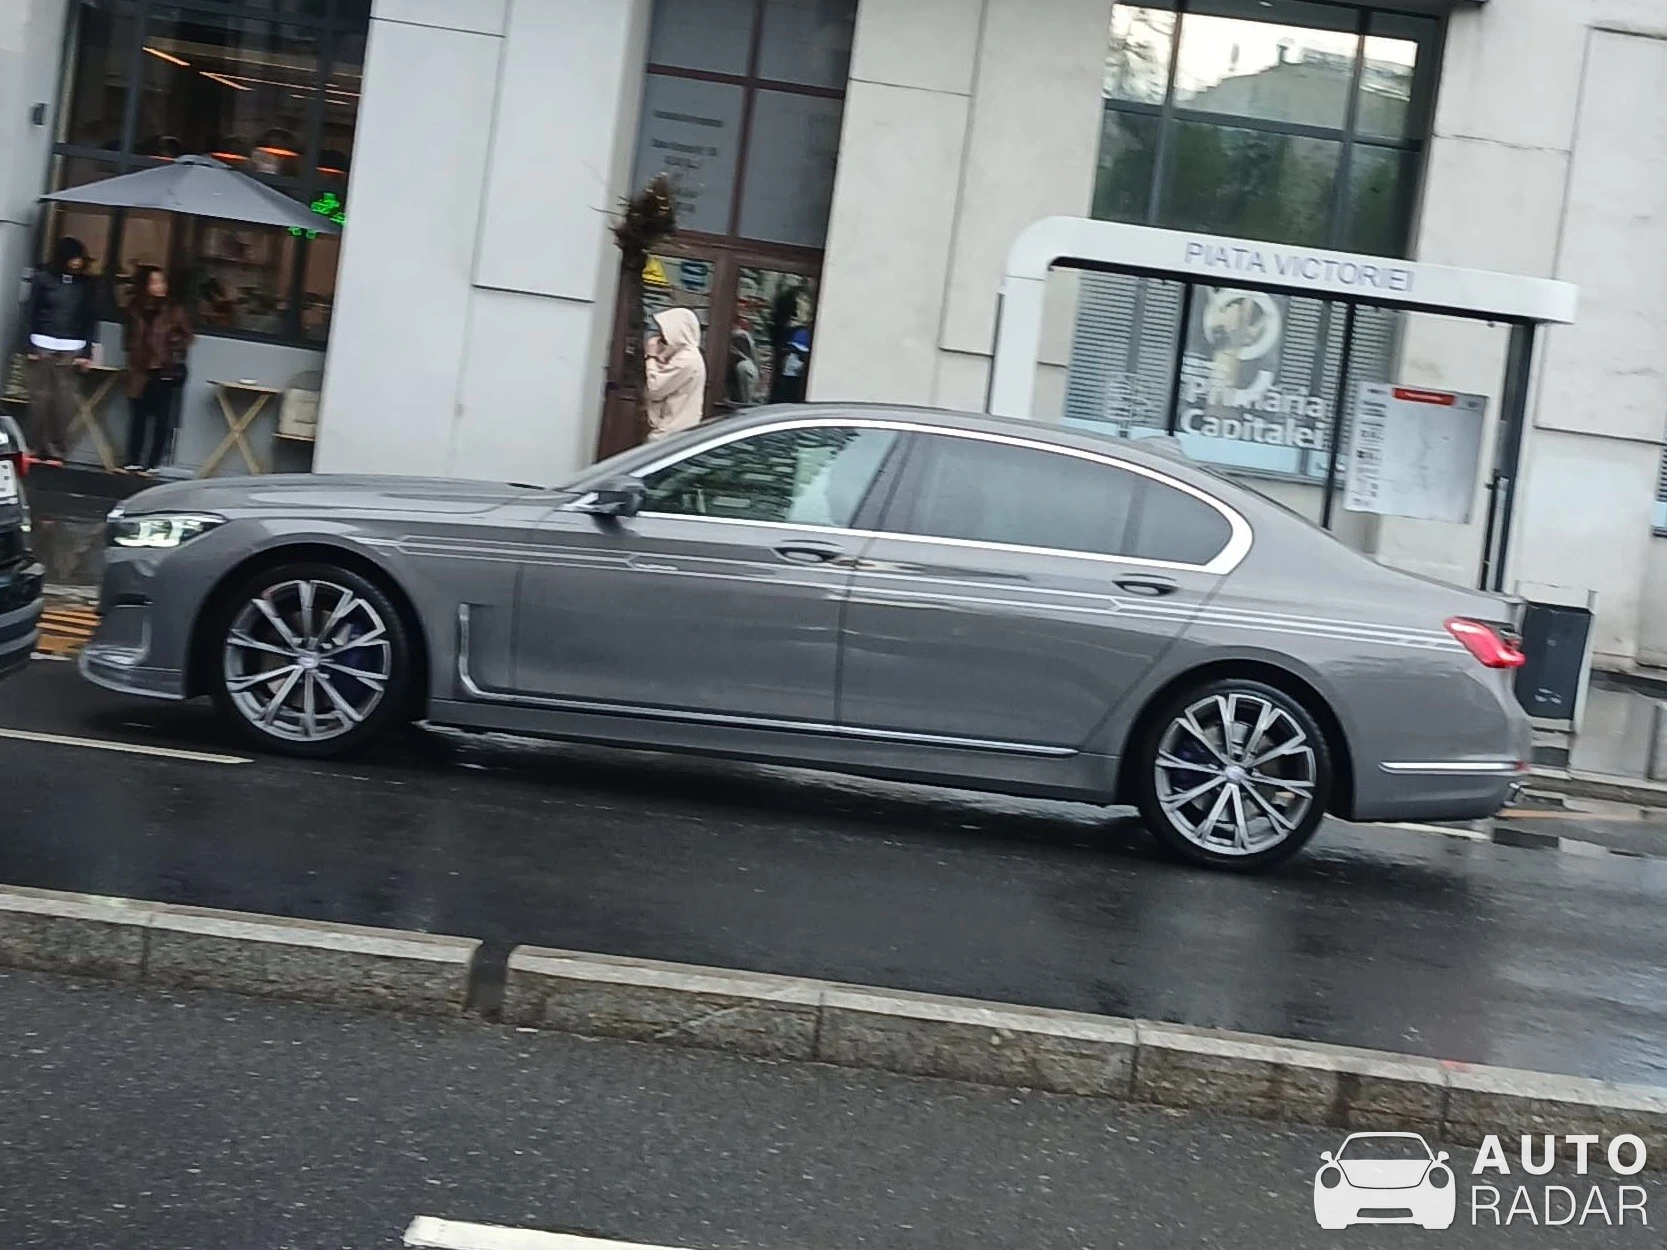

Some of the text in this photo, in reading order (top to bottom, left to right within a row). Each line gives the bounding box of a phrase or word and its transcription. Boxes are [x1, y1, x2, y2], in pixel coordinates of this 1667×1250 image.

[1184, 241, 1415, 293] PIATA VICTORIEI
[1179, 408, 1326, 449] Capitalei
